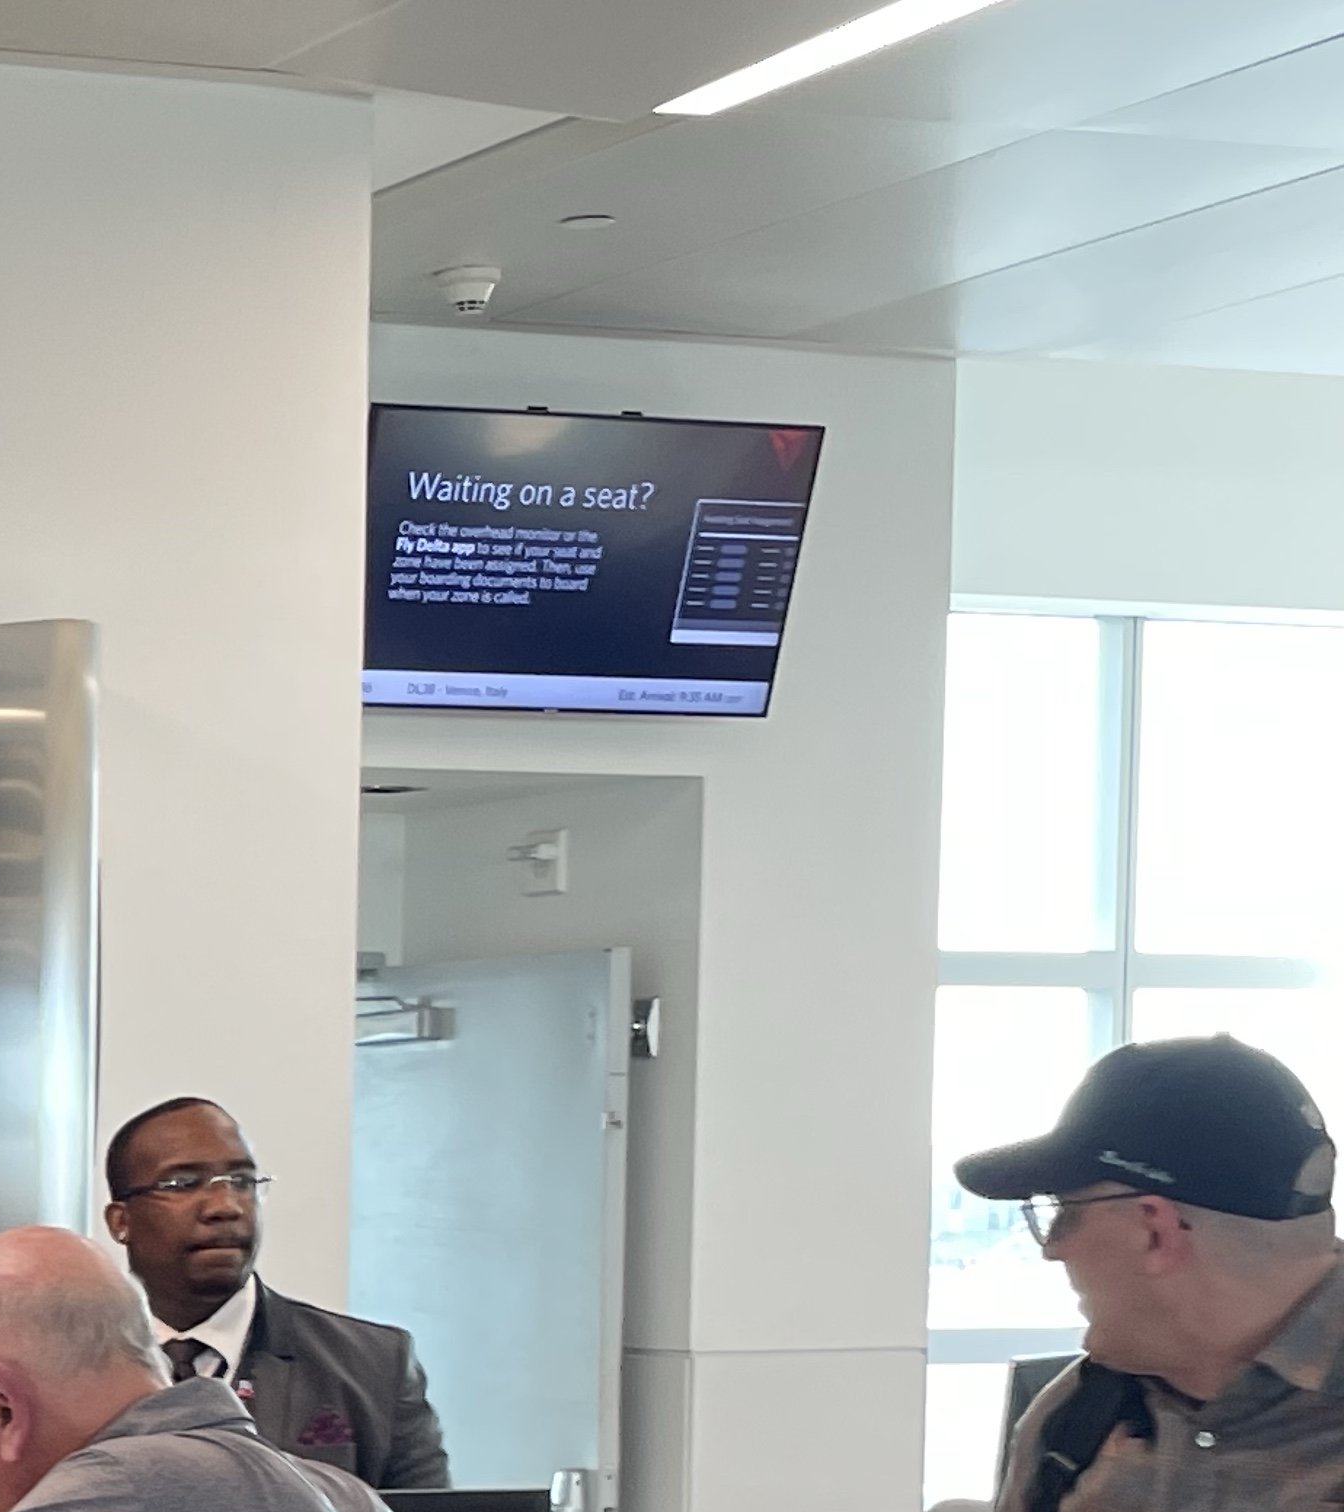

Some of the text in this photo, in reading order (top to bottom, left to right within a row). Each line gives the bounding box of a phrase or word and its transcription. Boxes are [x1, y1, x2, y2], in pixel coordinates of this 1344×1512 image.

[408, 471, 655, 511] Waiting on a seat?
[398, 520, 436, 537] Check
[396, 536, 414, 554] Fly
[416, 537, 451, 553] Delta
[451, 541, 476, 556] app
[477, 542, 490, 555] to
[491, 545, 512, 556] see
[472, 573, 538, 589] documents
[539, 576, 553, 590] to
[480, 589, 492, 604] is
